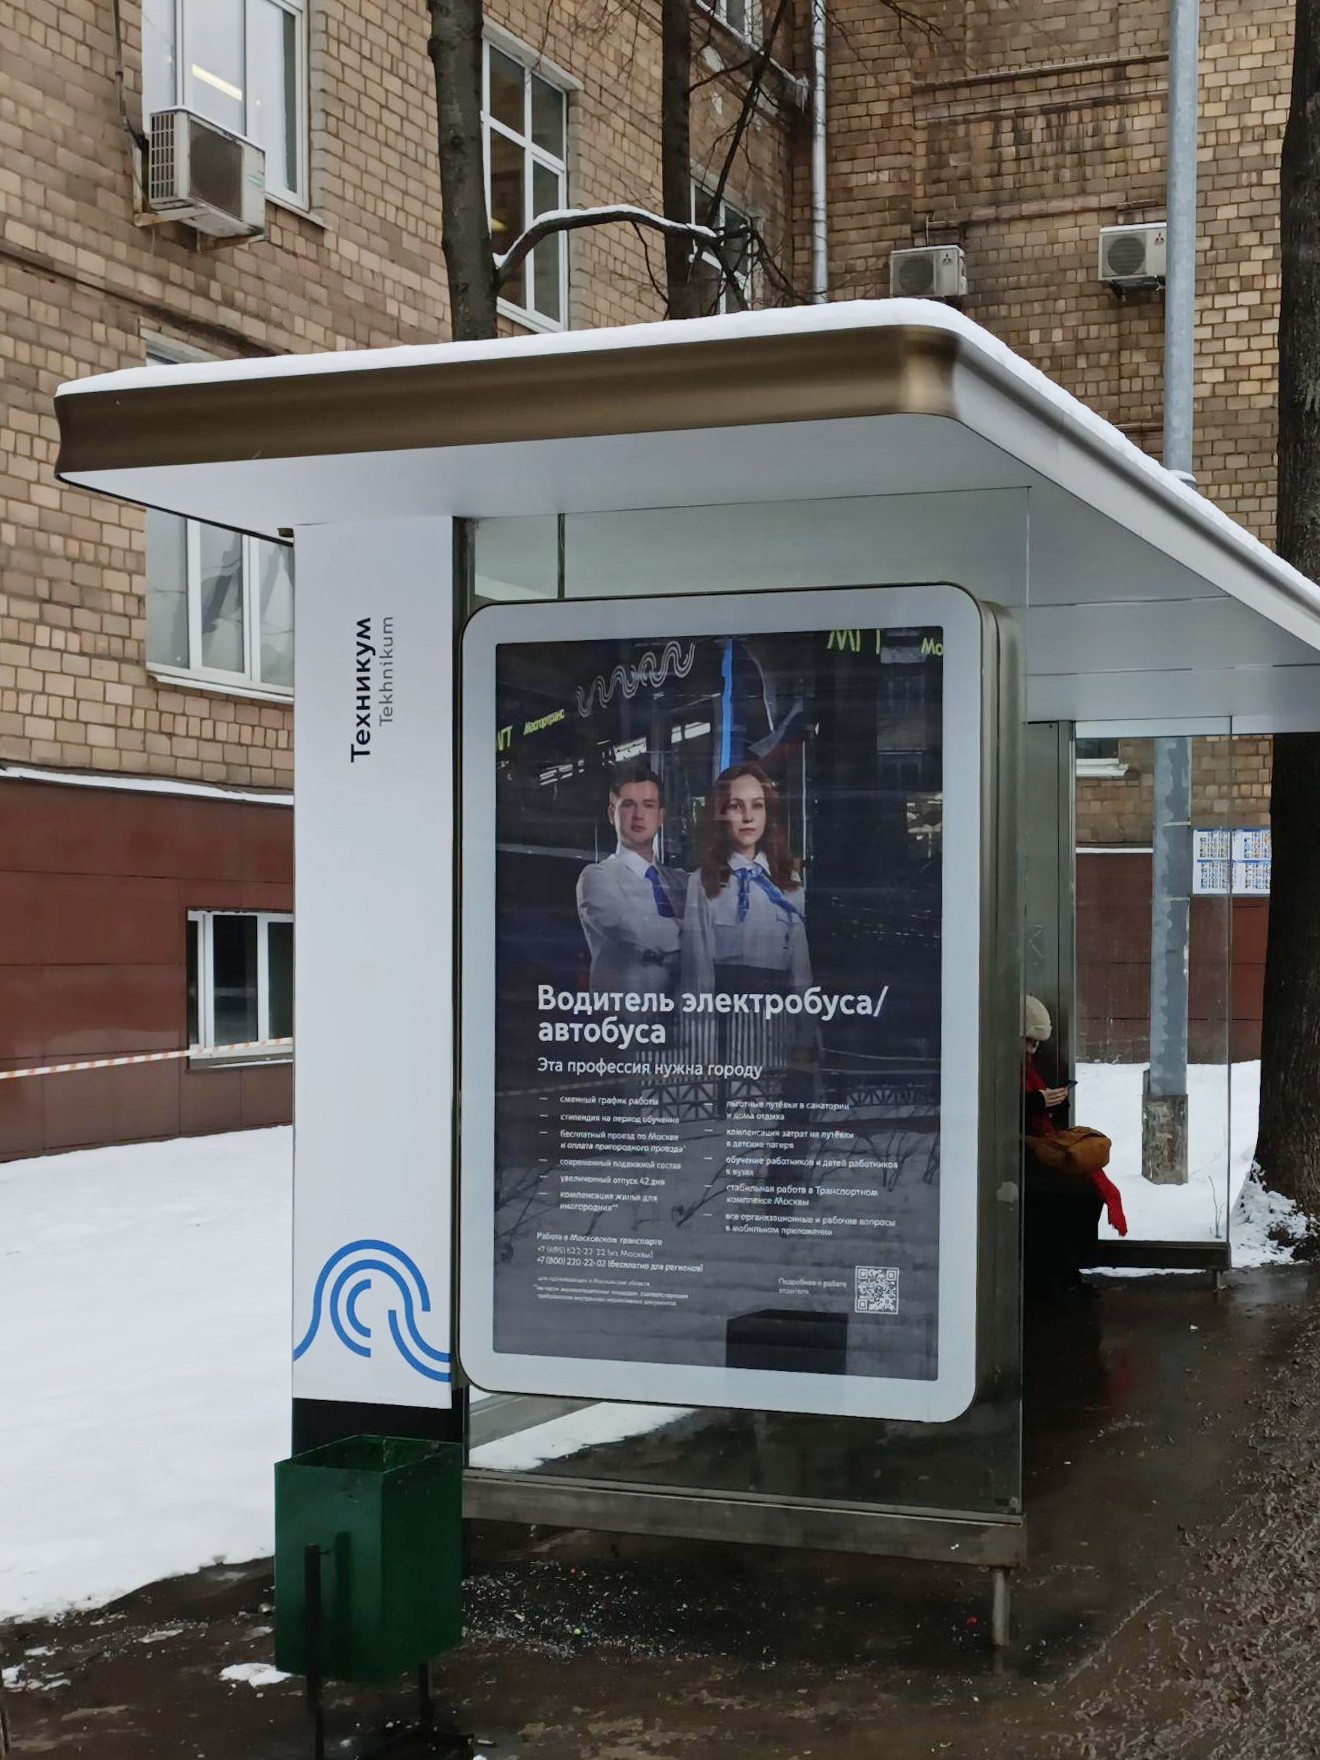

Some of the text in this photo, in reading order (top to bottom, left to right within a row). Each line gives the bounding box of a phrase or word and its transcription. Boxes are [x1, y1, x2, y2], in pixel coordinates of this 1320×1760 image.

[379, 617, 393, 726] Tekhnikum
[351, 618, 375, 763] Техникум
[538, 985, 889, 1021] Водитель электробуса/
[538, 1016, 666, 1050] автобуса
[537, 1058, 763, 1078] Эта профессия нужна городу
[560, 1096, 659, 1105] сменный график работы
[561, 1114, 599, 1122] стипендия
[643, 1115, 679, 1125] обучения
[561, 1130, 605, 1139] бесплатный
[649, 1133, 679, 1141] Москве
[726, 1129, 779, 1138] компенсация
[782, 1131, 807, 1139] затрат
[596, 1144, 649, 1152] пригородного
[560, 1159, 610, 1167] современный
[613, 1161, 654, 1169] подвижной
[726, 1157, 764, 1167] обучение
[766, 1157, 814, 1167] работников
[823, 1158, 846, 1168] детей
[849, 1158, 898, 1169] работников
[560, 1175, 610, 1184] увеличенный
[613, 1178, 638, 1186] отпуск
[640, 1177, 649, 1185] 42
[726, 1183, 774, 1193] стабильная
[777, 1184, 806, 1194] работа
[816, 1185, 878, 1197] Транспортном
[560, 1192, 613, 1200] компенсация
[774, 1197, 809, 1206] Москвы
[823, 1215, 857, 1226] рабочие
[860, 1218, 895, 1228] вопросы
[733, 1224, 779, 1234] мобильном
[570, 1234, 617, 1243] Московском
